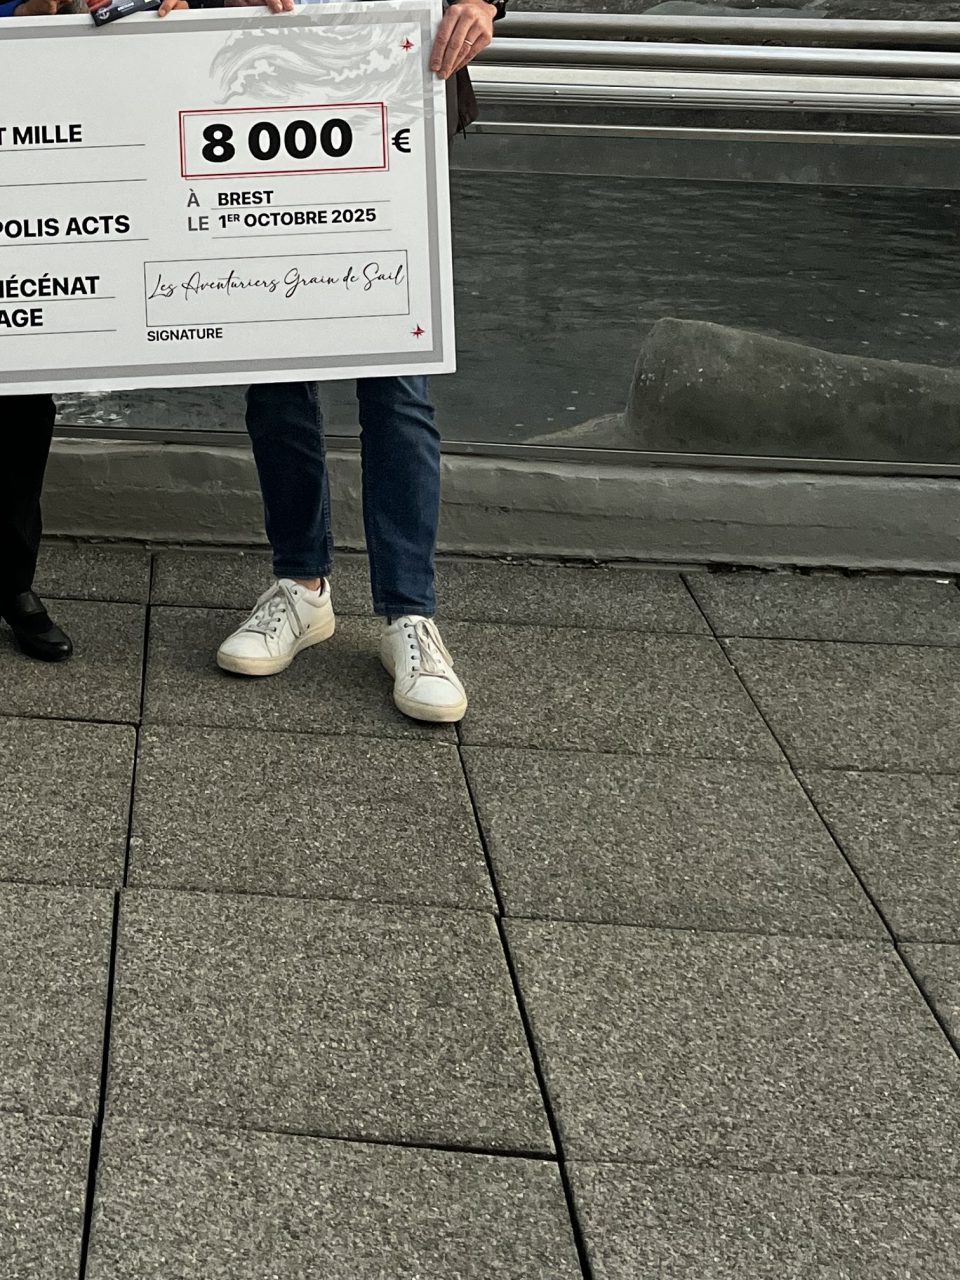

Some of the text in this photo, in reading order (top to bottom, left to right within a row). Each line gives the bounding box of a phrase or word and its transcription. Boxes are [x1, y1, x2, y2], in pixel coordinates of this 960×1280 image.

[13, 124, 82, 145] MILLE
[202, 118, 411, 162] 8 000 €
[187, 188, 274, 207] À BREST
[65, 215, 130, 236] ACTS
[188, 216, 209, 231] LE
[244, 210, 327, 227] OCTOBRE
[332, 208, 376, 223] 2025
[148, 262, 404, 300] Les Aventuriers Grain de Sail
[147, 328, 223, 341] SIGNATURE
